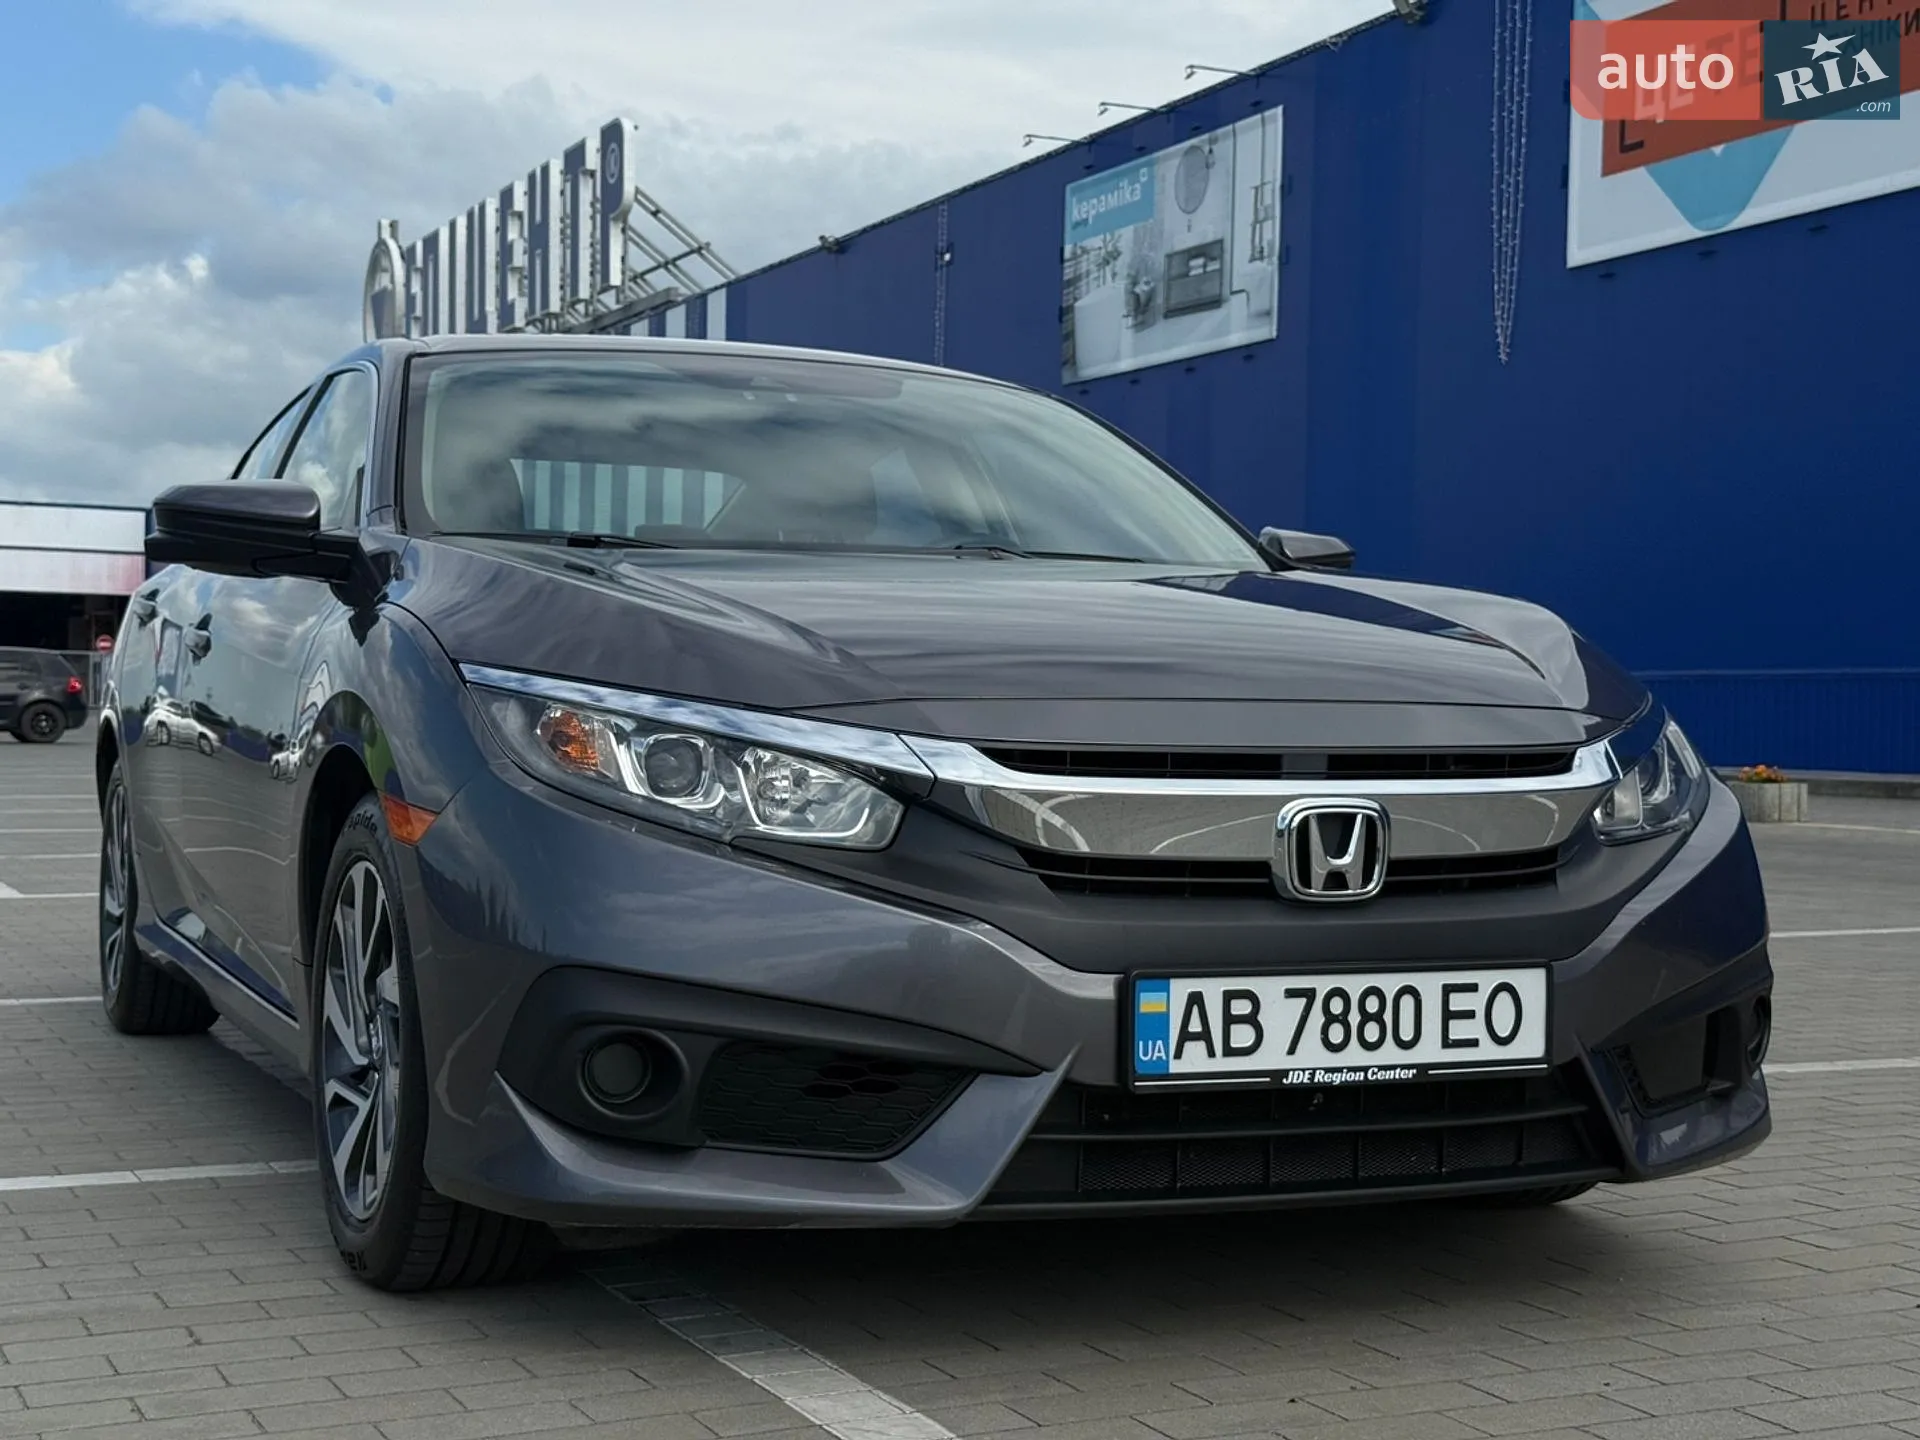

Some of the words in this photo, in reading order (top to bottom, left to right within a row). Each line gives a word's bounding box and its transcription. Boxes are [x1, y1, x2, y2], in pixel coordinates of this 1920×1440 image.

[1173, 988, 1264, 1060] AB
[1283, 984, 1423, 1056] 7880
[1441, 981, 1523, 1049] EO
[1138, 1040, 1167, 1061] UA
[1282, 1070, 1313, 1084] JDE
[1313, 1069, 1365, 1085] Region
[1367, 1067, 1417, 1080] Center
